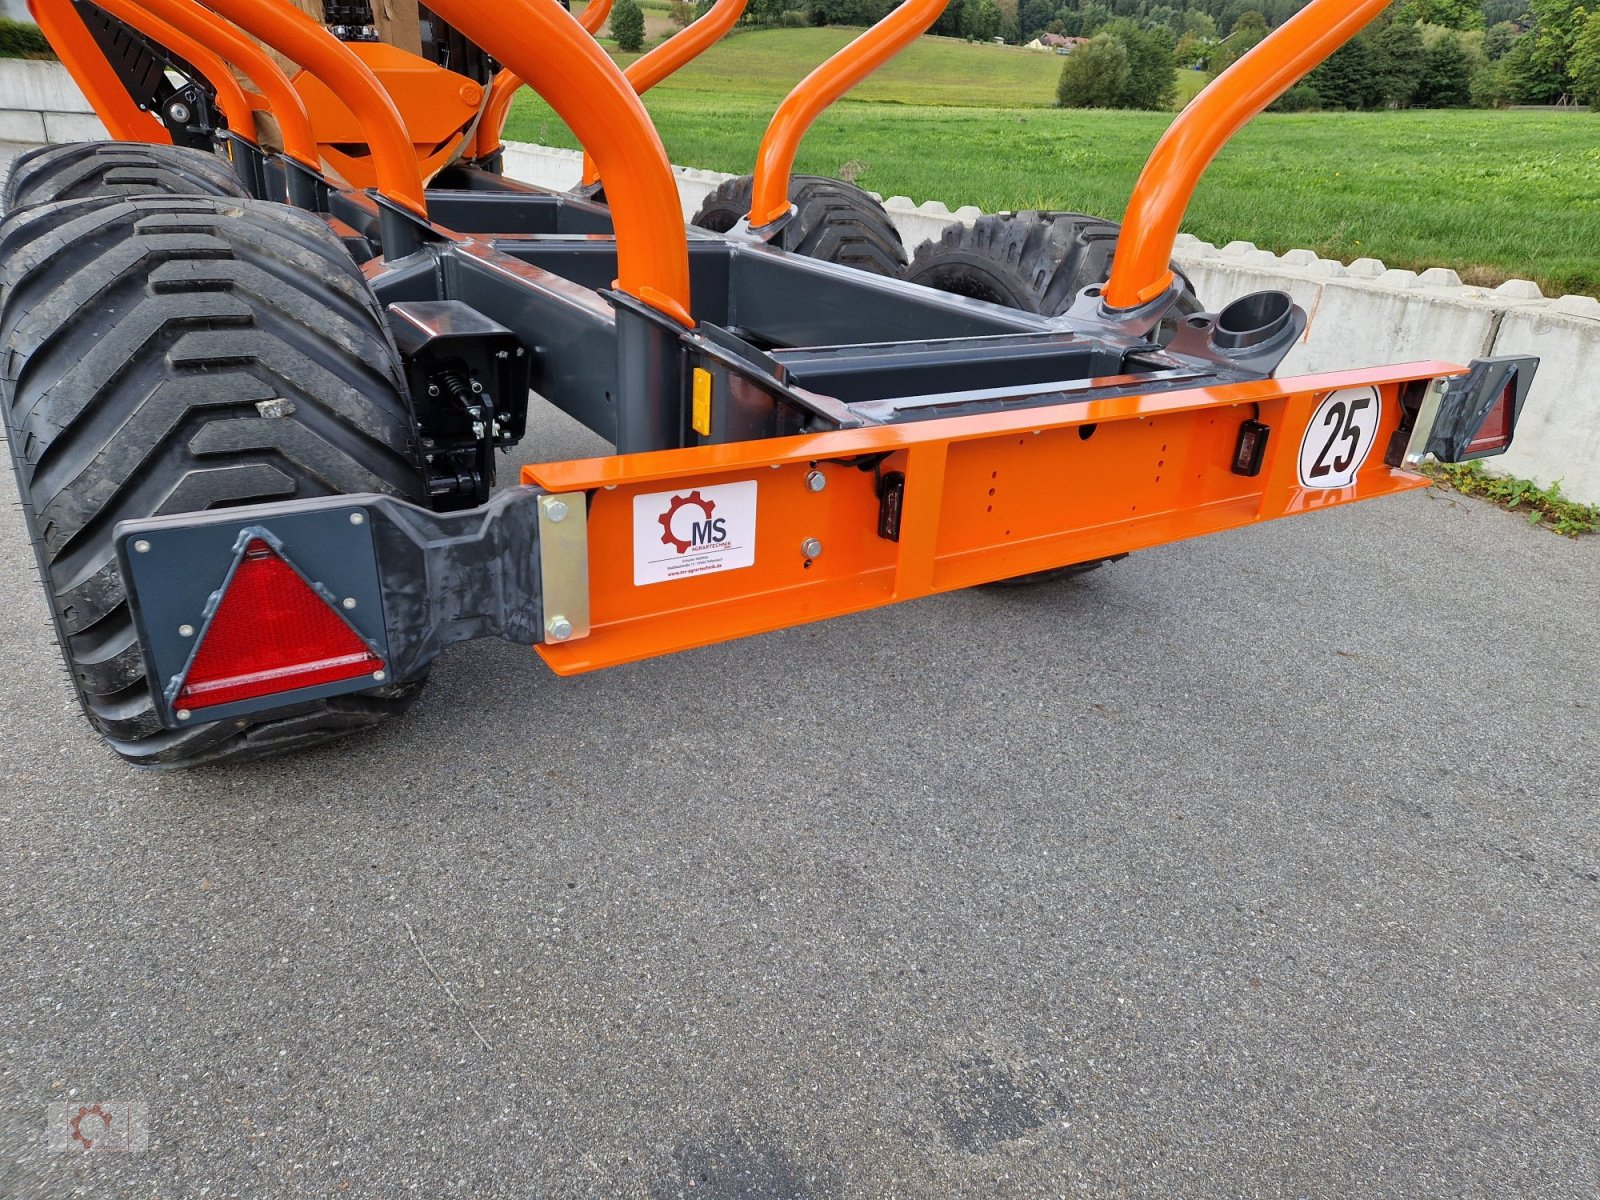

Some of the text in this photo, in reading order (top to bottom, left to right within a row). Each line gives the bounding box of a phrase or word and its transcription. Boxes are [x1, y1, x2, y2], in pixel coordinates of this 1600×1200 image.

[1309, 398, 1371, 479] 25
[692, 517, 727, 546] MS
[691, 541, 732, 552] AGRARTECHNIK
